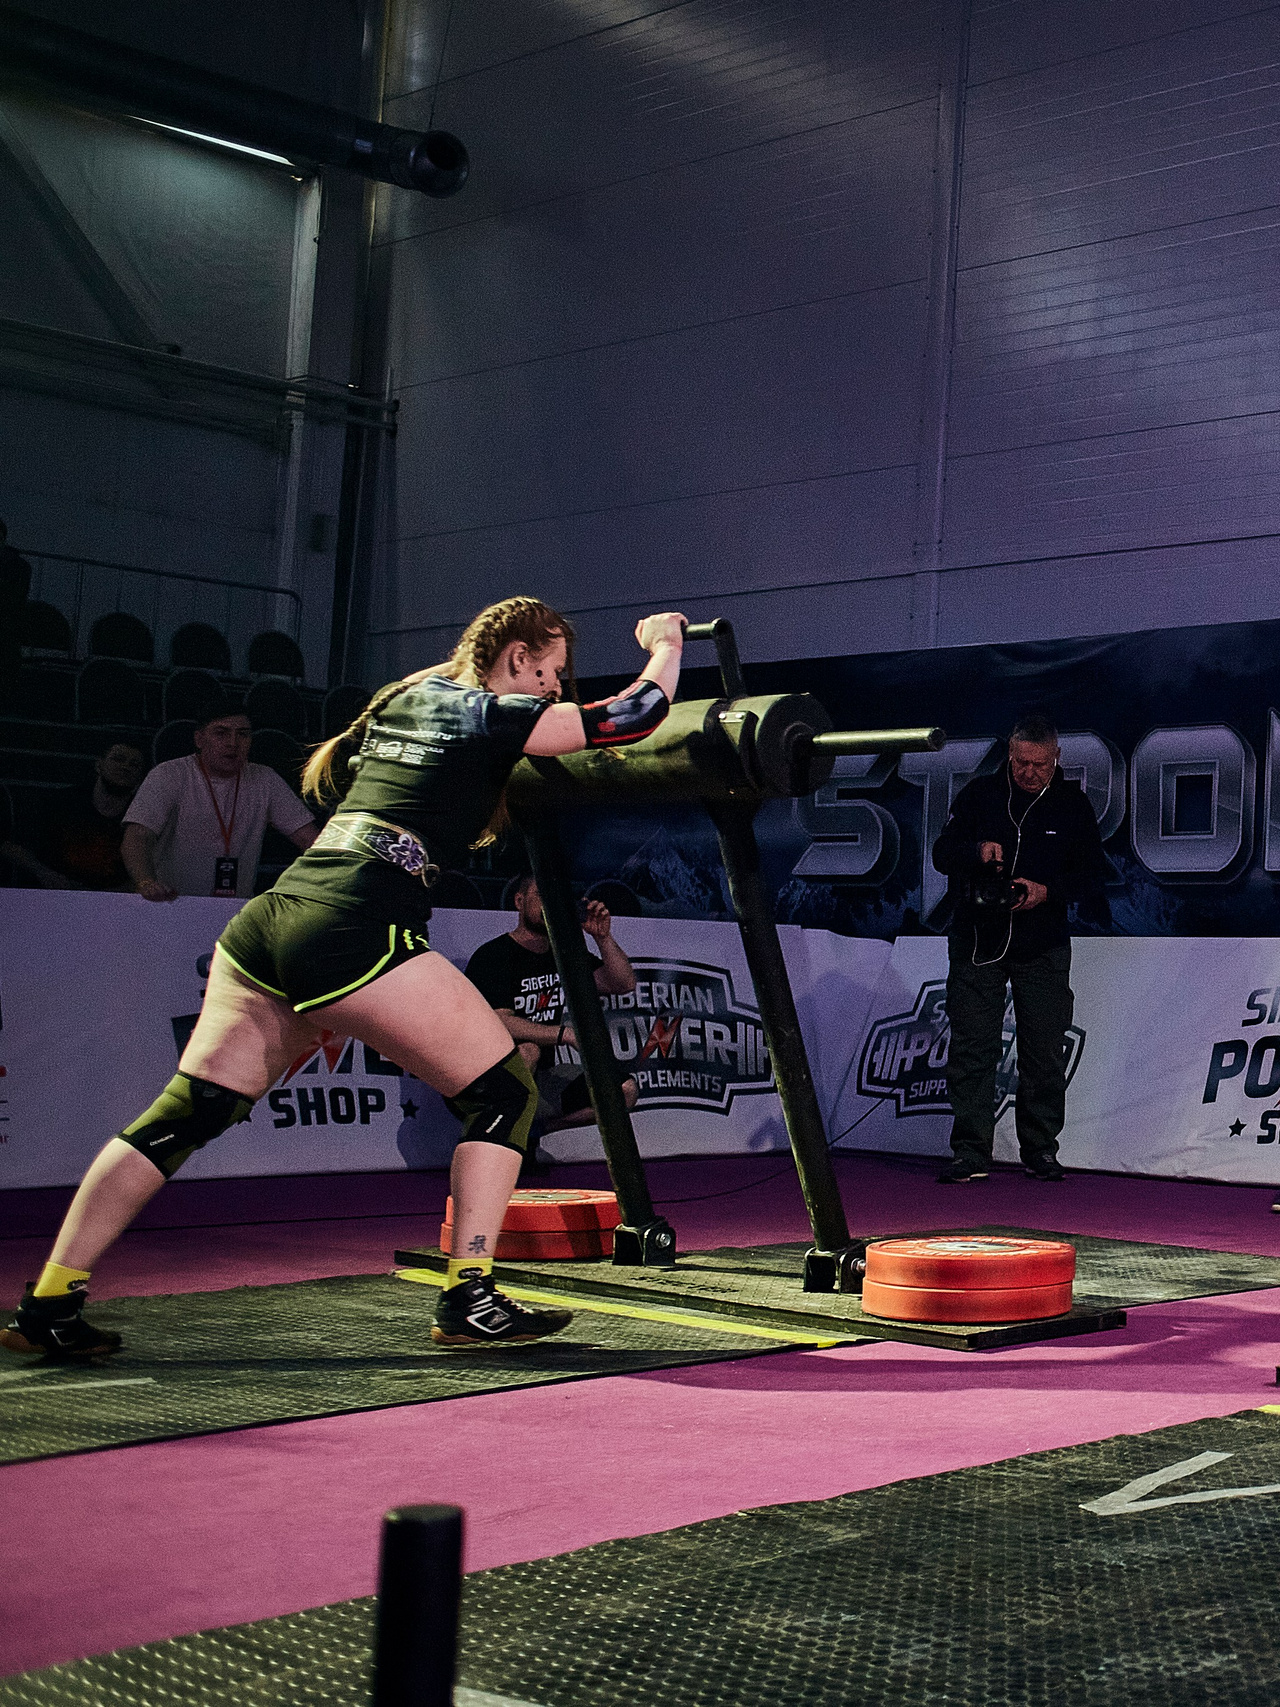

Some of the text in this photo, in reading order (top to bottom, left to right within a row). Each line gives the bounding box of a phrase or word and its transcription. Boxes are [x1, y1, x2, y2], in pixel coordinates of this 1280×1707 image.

[520, 972, 561, 993] SIBERIA
[608, 1011, 733, 1066] OWER
[628, 1069, 722, 1093] PLEMENTS
[268, 1086, 386, 1129] SHOP
